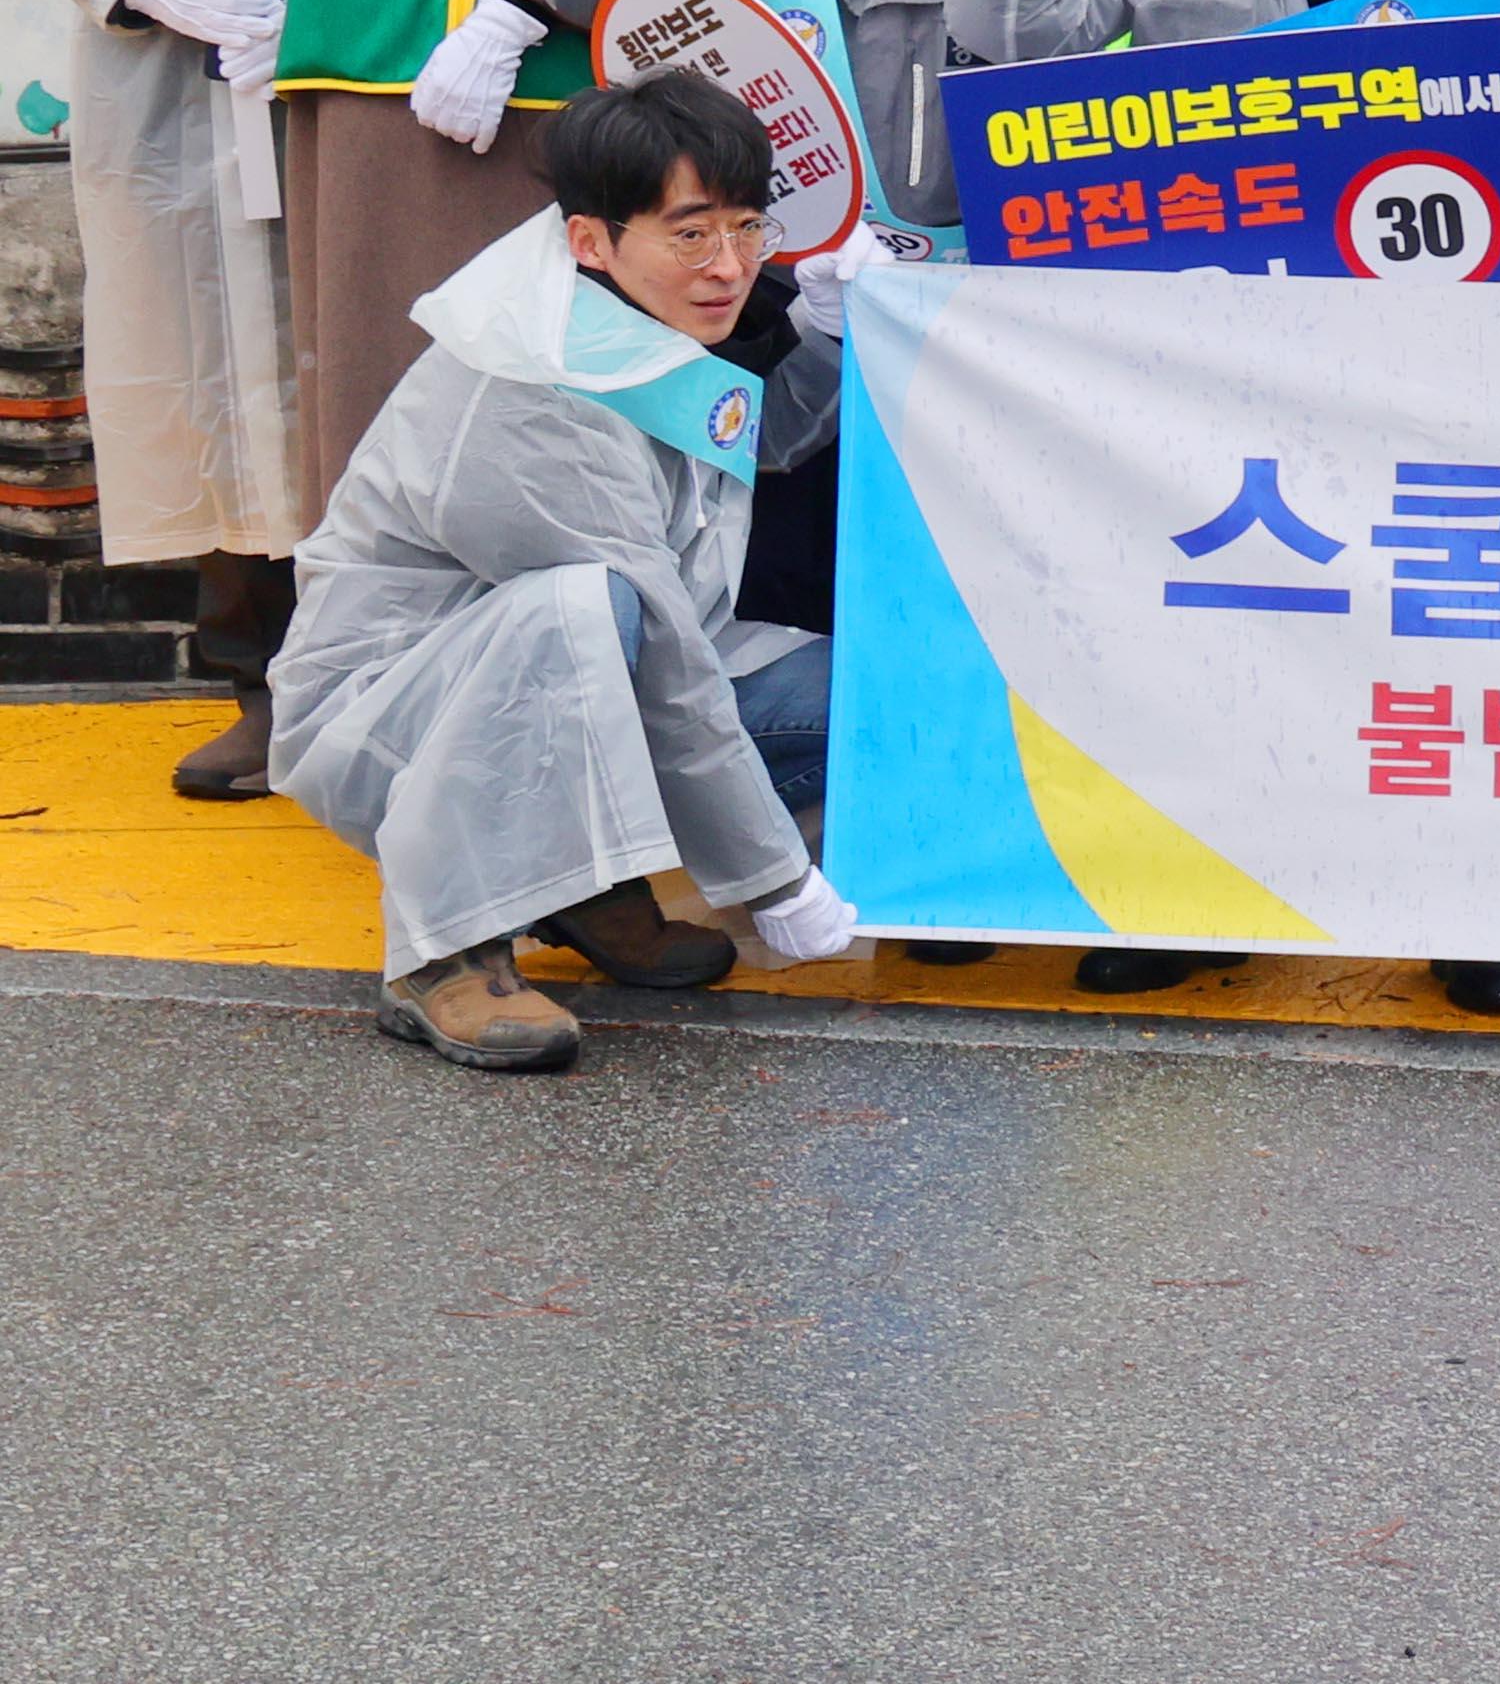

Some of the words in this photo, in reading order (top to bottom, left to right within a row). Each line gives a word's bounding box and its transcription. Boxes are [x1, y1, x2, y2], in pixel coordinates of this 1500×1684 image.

[788, 142, 847, 189] 걷다!
[1003, 162, 1305, 261] 안전속도
[1376, 193, 1464, 263] 30
